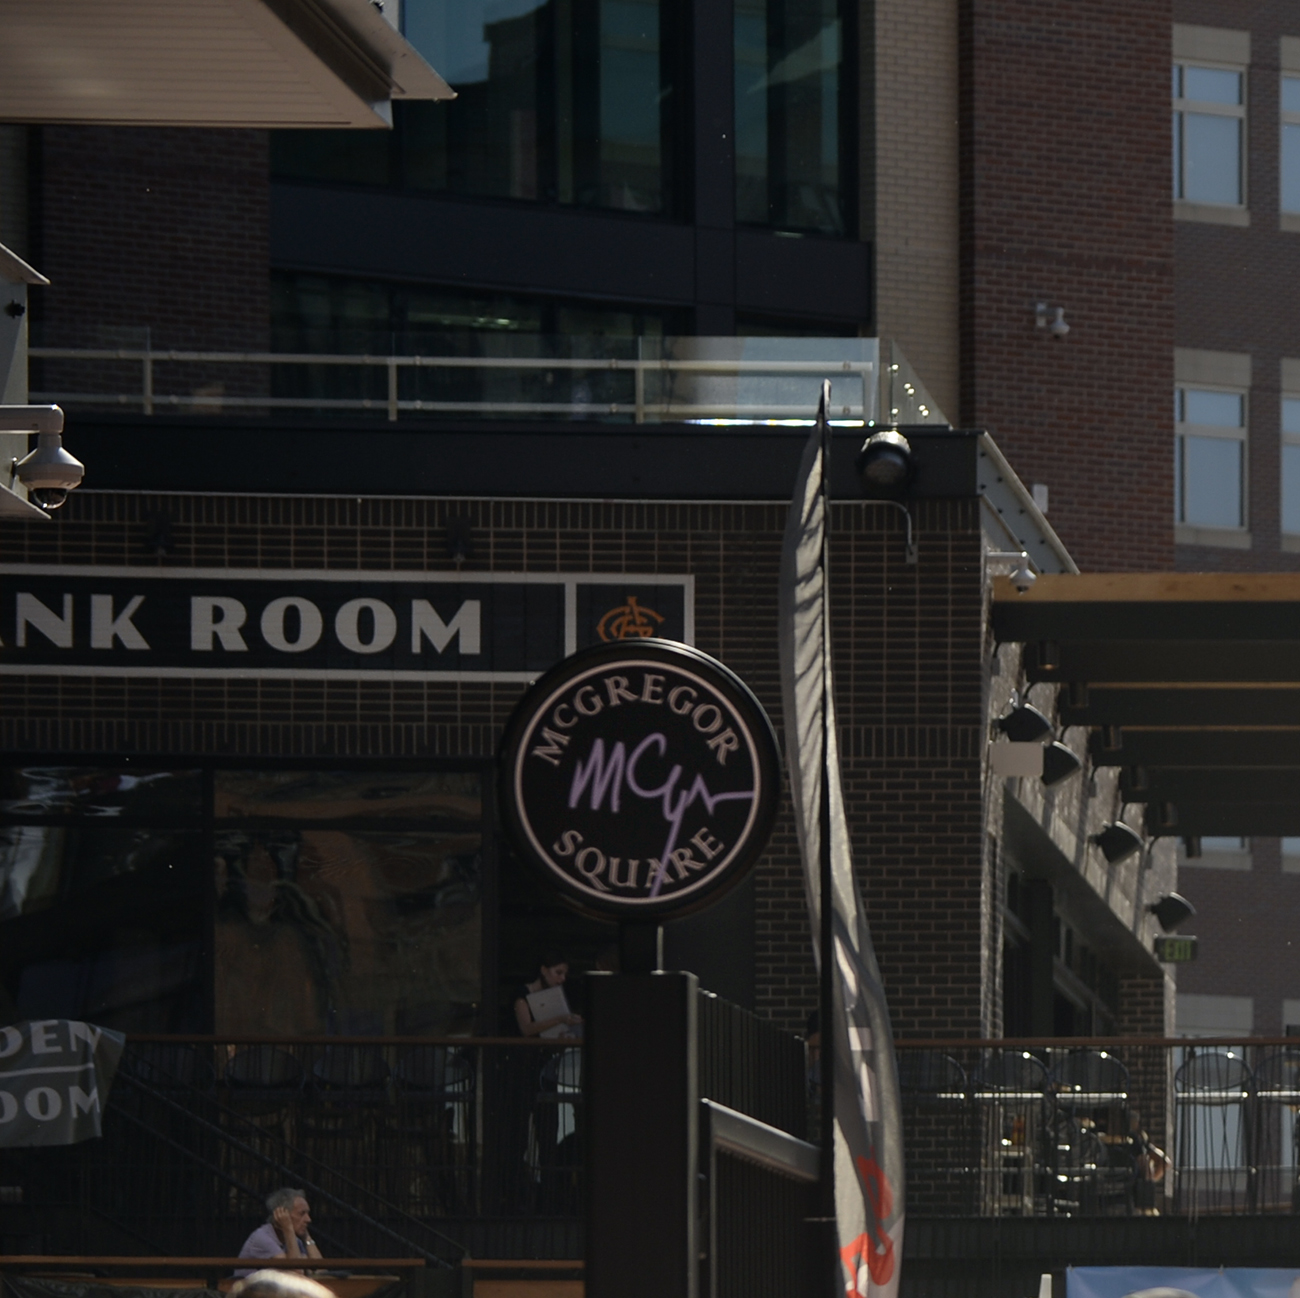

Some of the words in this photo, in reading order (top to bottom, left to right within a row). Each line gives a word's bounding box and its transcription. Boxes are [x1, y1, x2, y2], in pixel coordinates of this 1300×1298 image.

[0, 591, 151, 650] NK
[190, 595, 482, 656] ROOM
[553, 826, 725, 892] SQUARE
